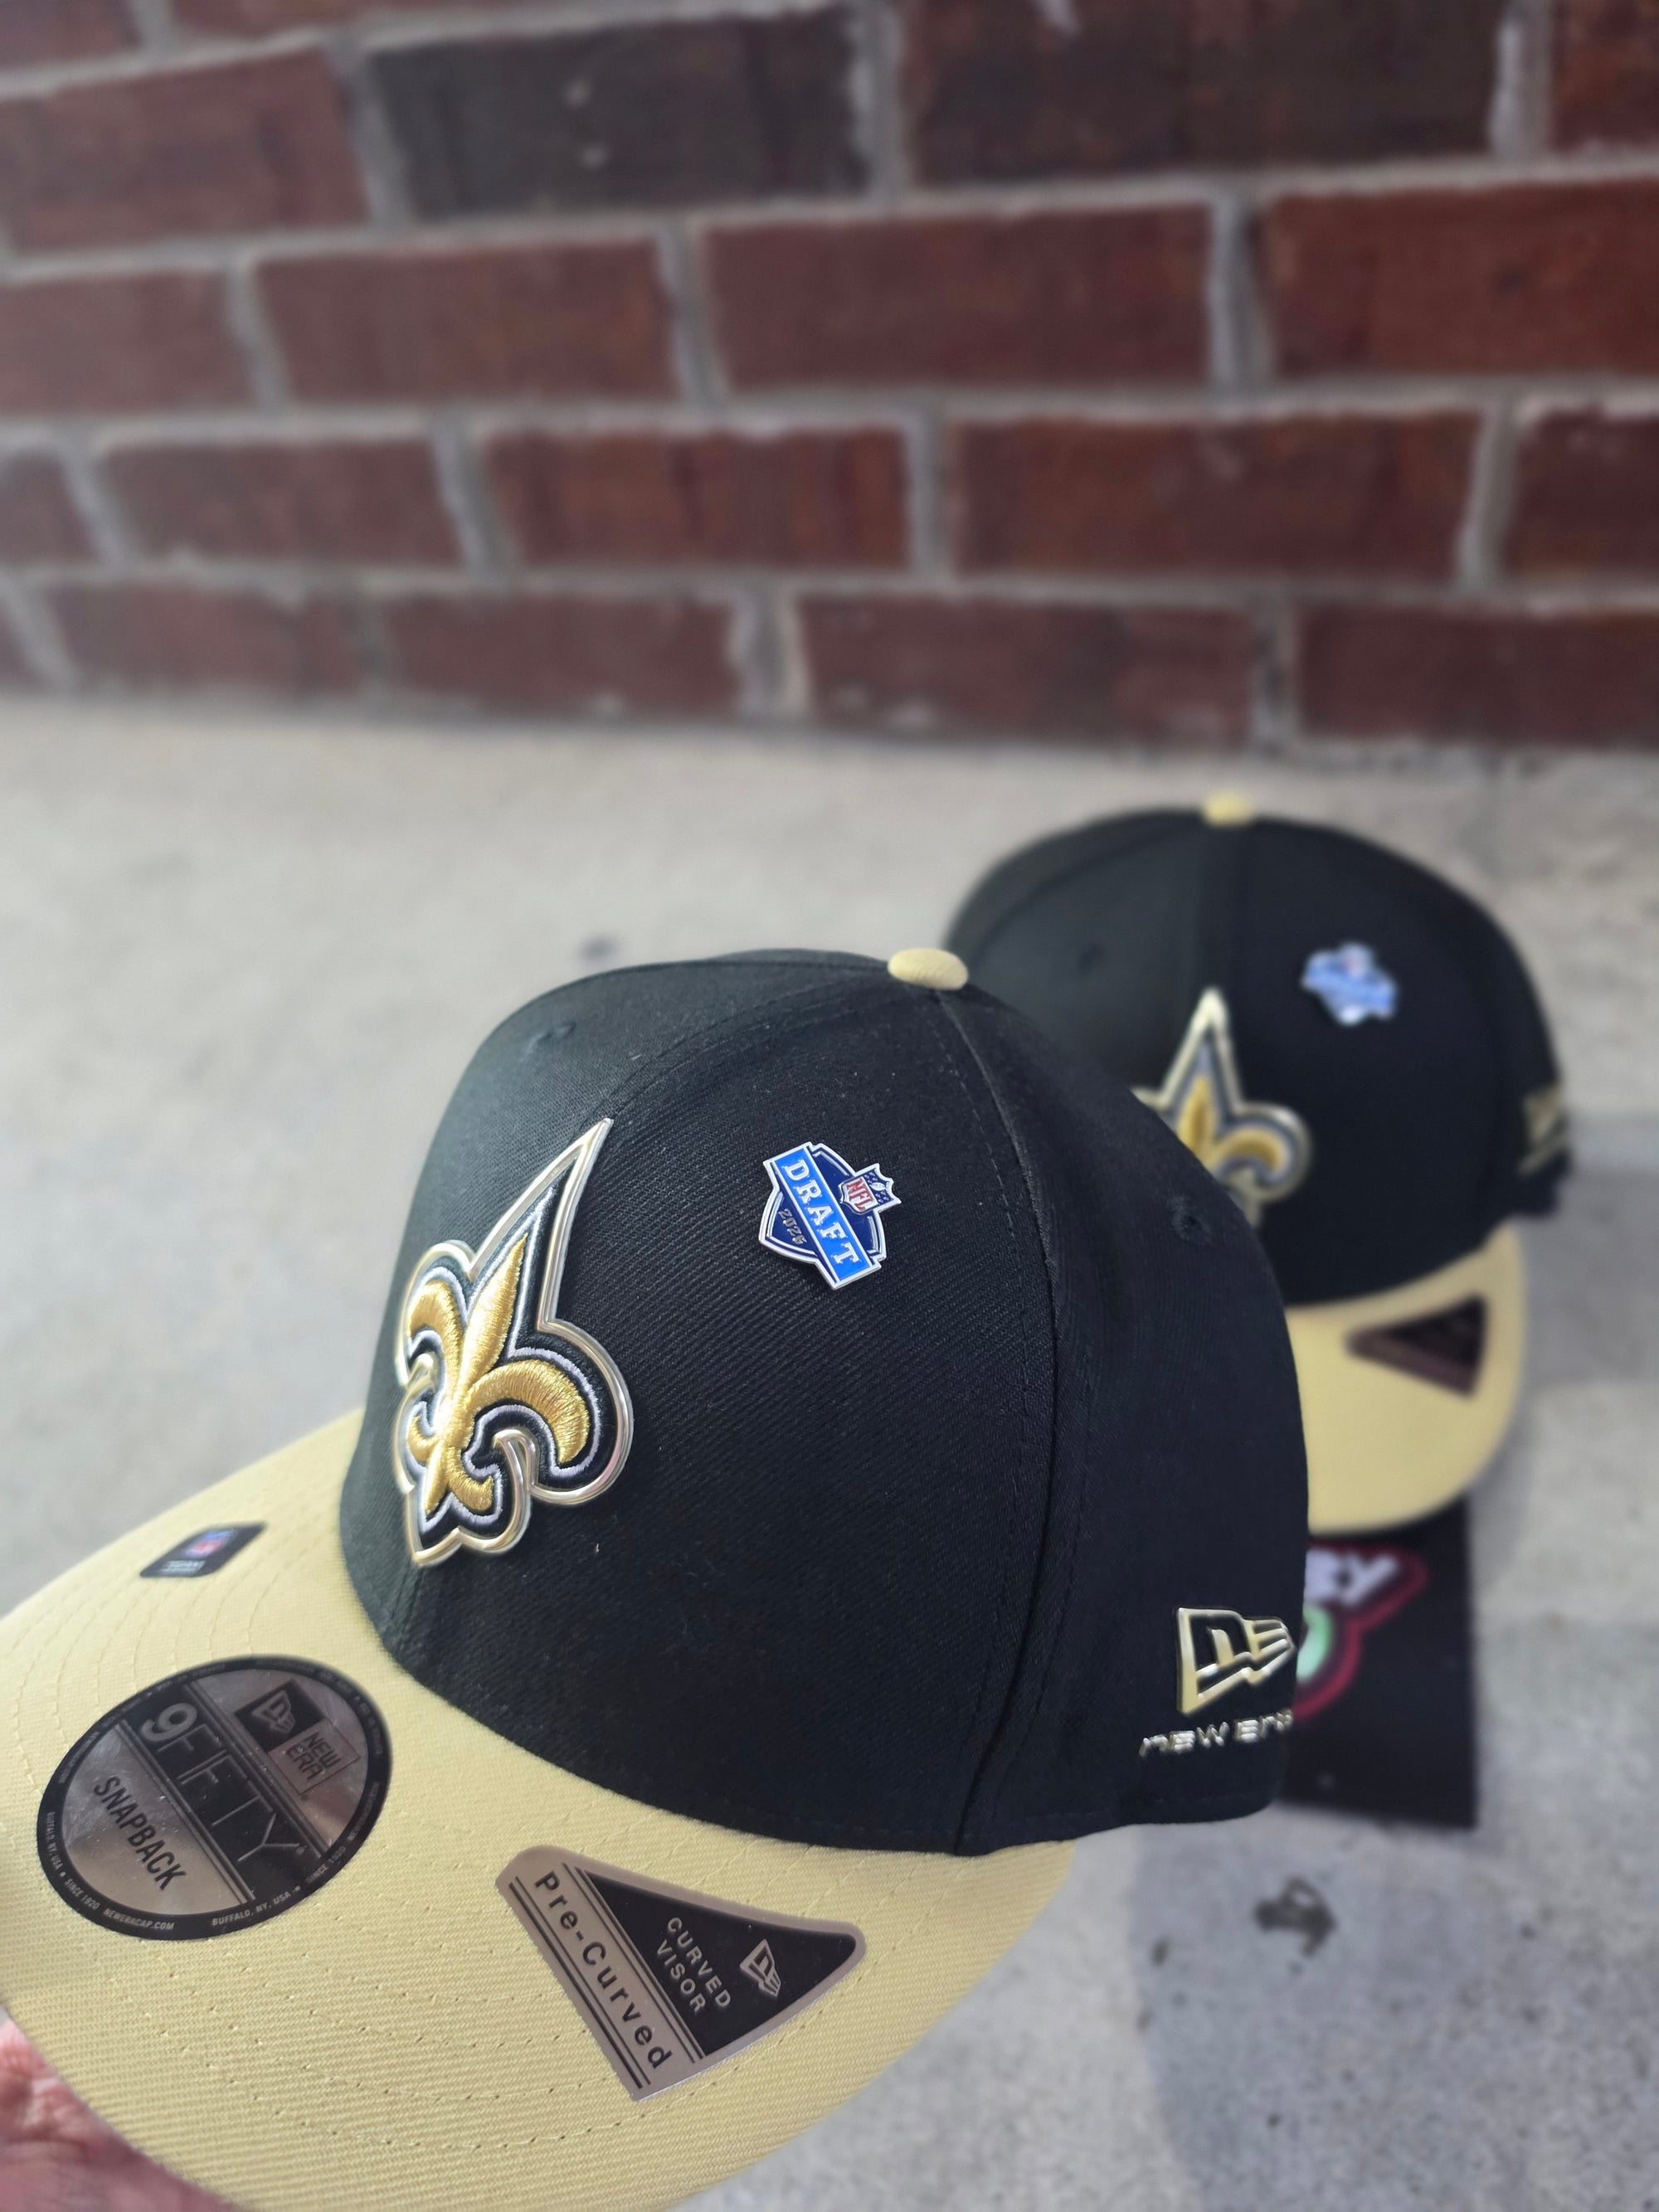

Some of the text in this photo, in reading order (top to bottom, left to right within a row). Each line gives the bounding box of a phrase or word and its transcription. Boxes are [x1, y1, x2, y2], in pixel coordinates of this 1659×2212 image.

[782, 1159, 861, 1265] DRAFT
[846, 1178, 875, 1212] NFL
[141, 1702, 300, 1862] 9FIFTY
[286, 1743, 326, 1781] ERA
[303, 1732, 341, 1769] NEW
[94, 1776, 187, 1891] SNAPBACK
[51, 1853, 64, 1871] USA
[64, 1878, 85, 1898] SINCE
[80, 1894, 100, 1910] 1920
[212, 1908, 254, 1927] BUFFALO,
[272, 1891, 292, 1905] USA
[103, 1908, 175, 1931] NEWERACAP.COM
[534, 1870, 673, 2069] Pre-Curved
[655, 1940, 707, 2014] VISOR
[666, 1917, 732, 2008] CURVED
